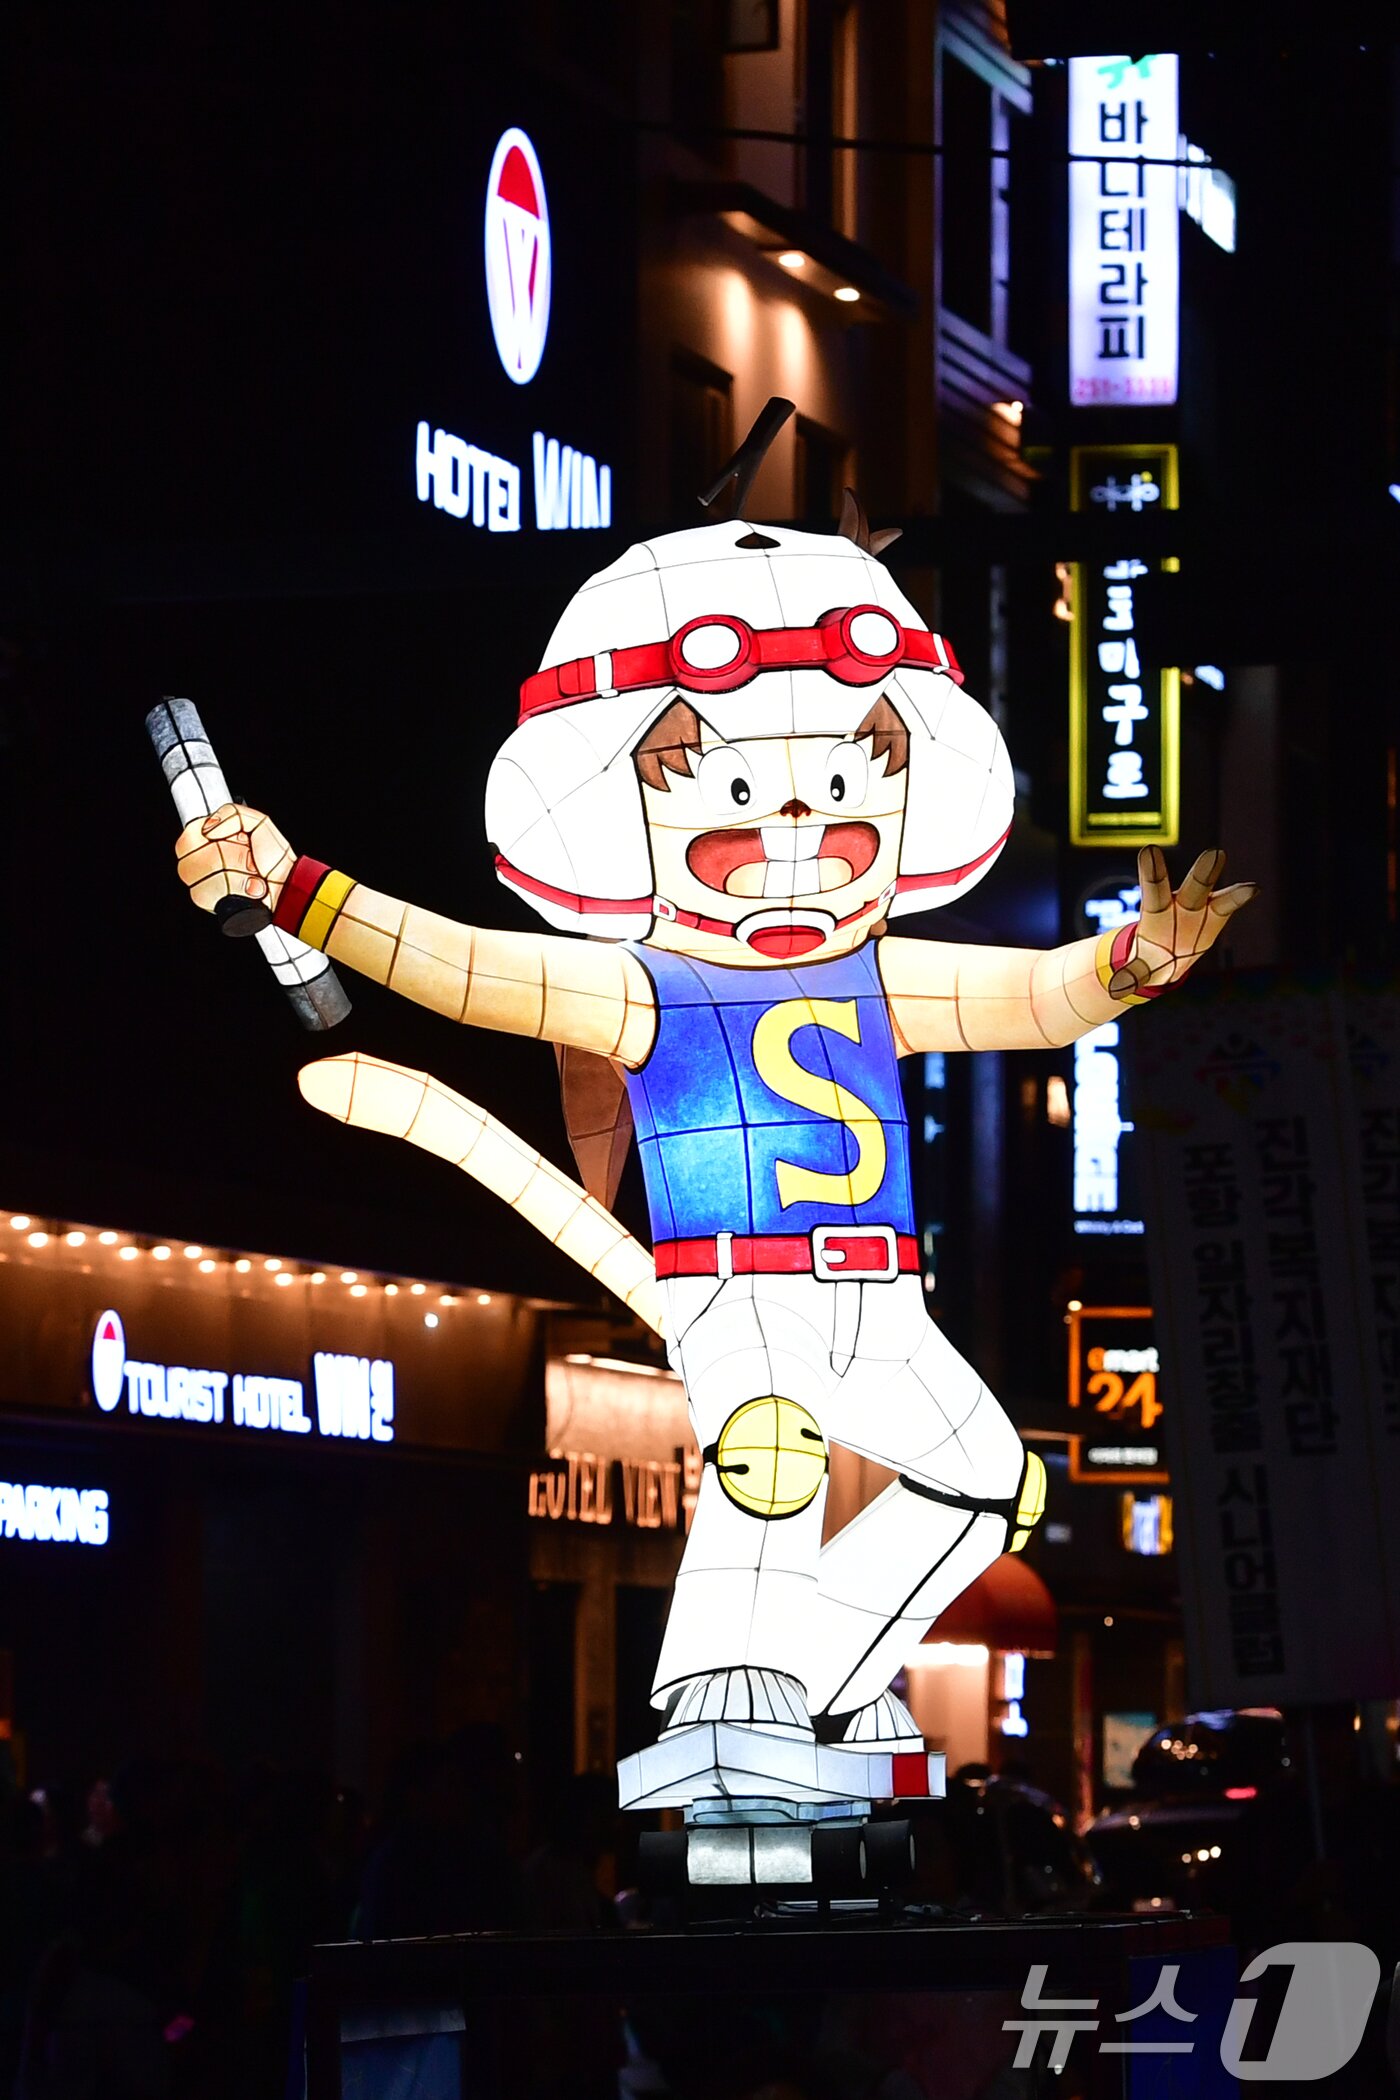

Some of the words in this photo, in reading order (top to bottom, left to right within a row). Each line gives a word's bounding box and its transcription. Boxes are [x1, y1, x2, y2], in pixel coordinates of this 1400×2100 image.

[417, 421, 520, 531] HOTEL
[533, 431, 611, 530] WIN
[752, 998, 886, 1212] S
[1184, 1143, 1242, 1227] 포항
[1255, 1116, 1340, 1456] 진각복지재단
[124, 1360, 228, 1422] TOURIST
[233, 1374, 312, 1433] HOTEL
[1087, 1372, 1164, 1428] 24
[1194, 1240, 1262, 1453] 일자리창출
[0, 1482, 109, 1545] PARKING
[1219, 1464, 1284, 1677] 시니어클럽
